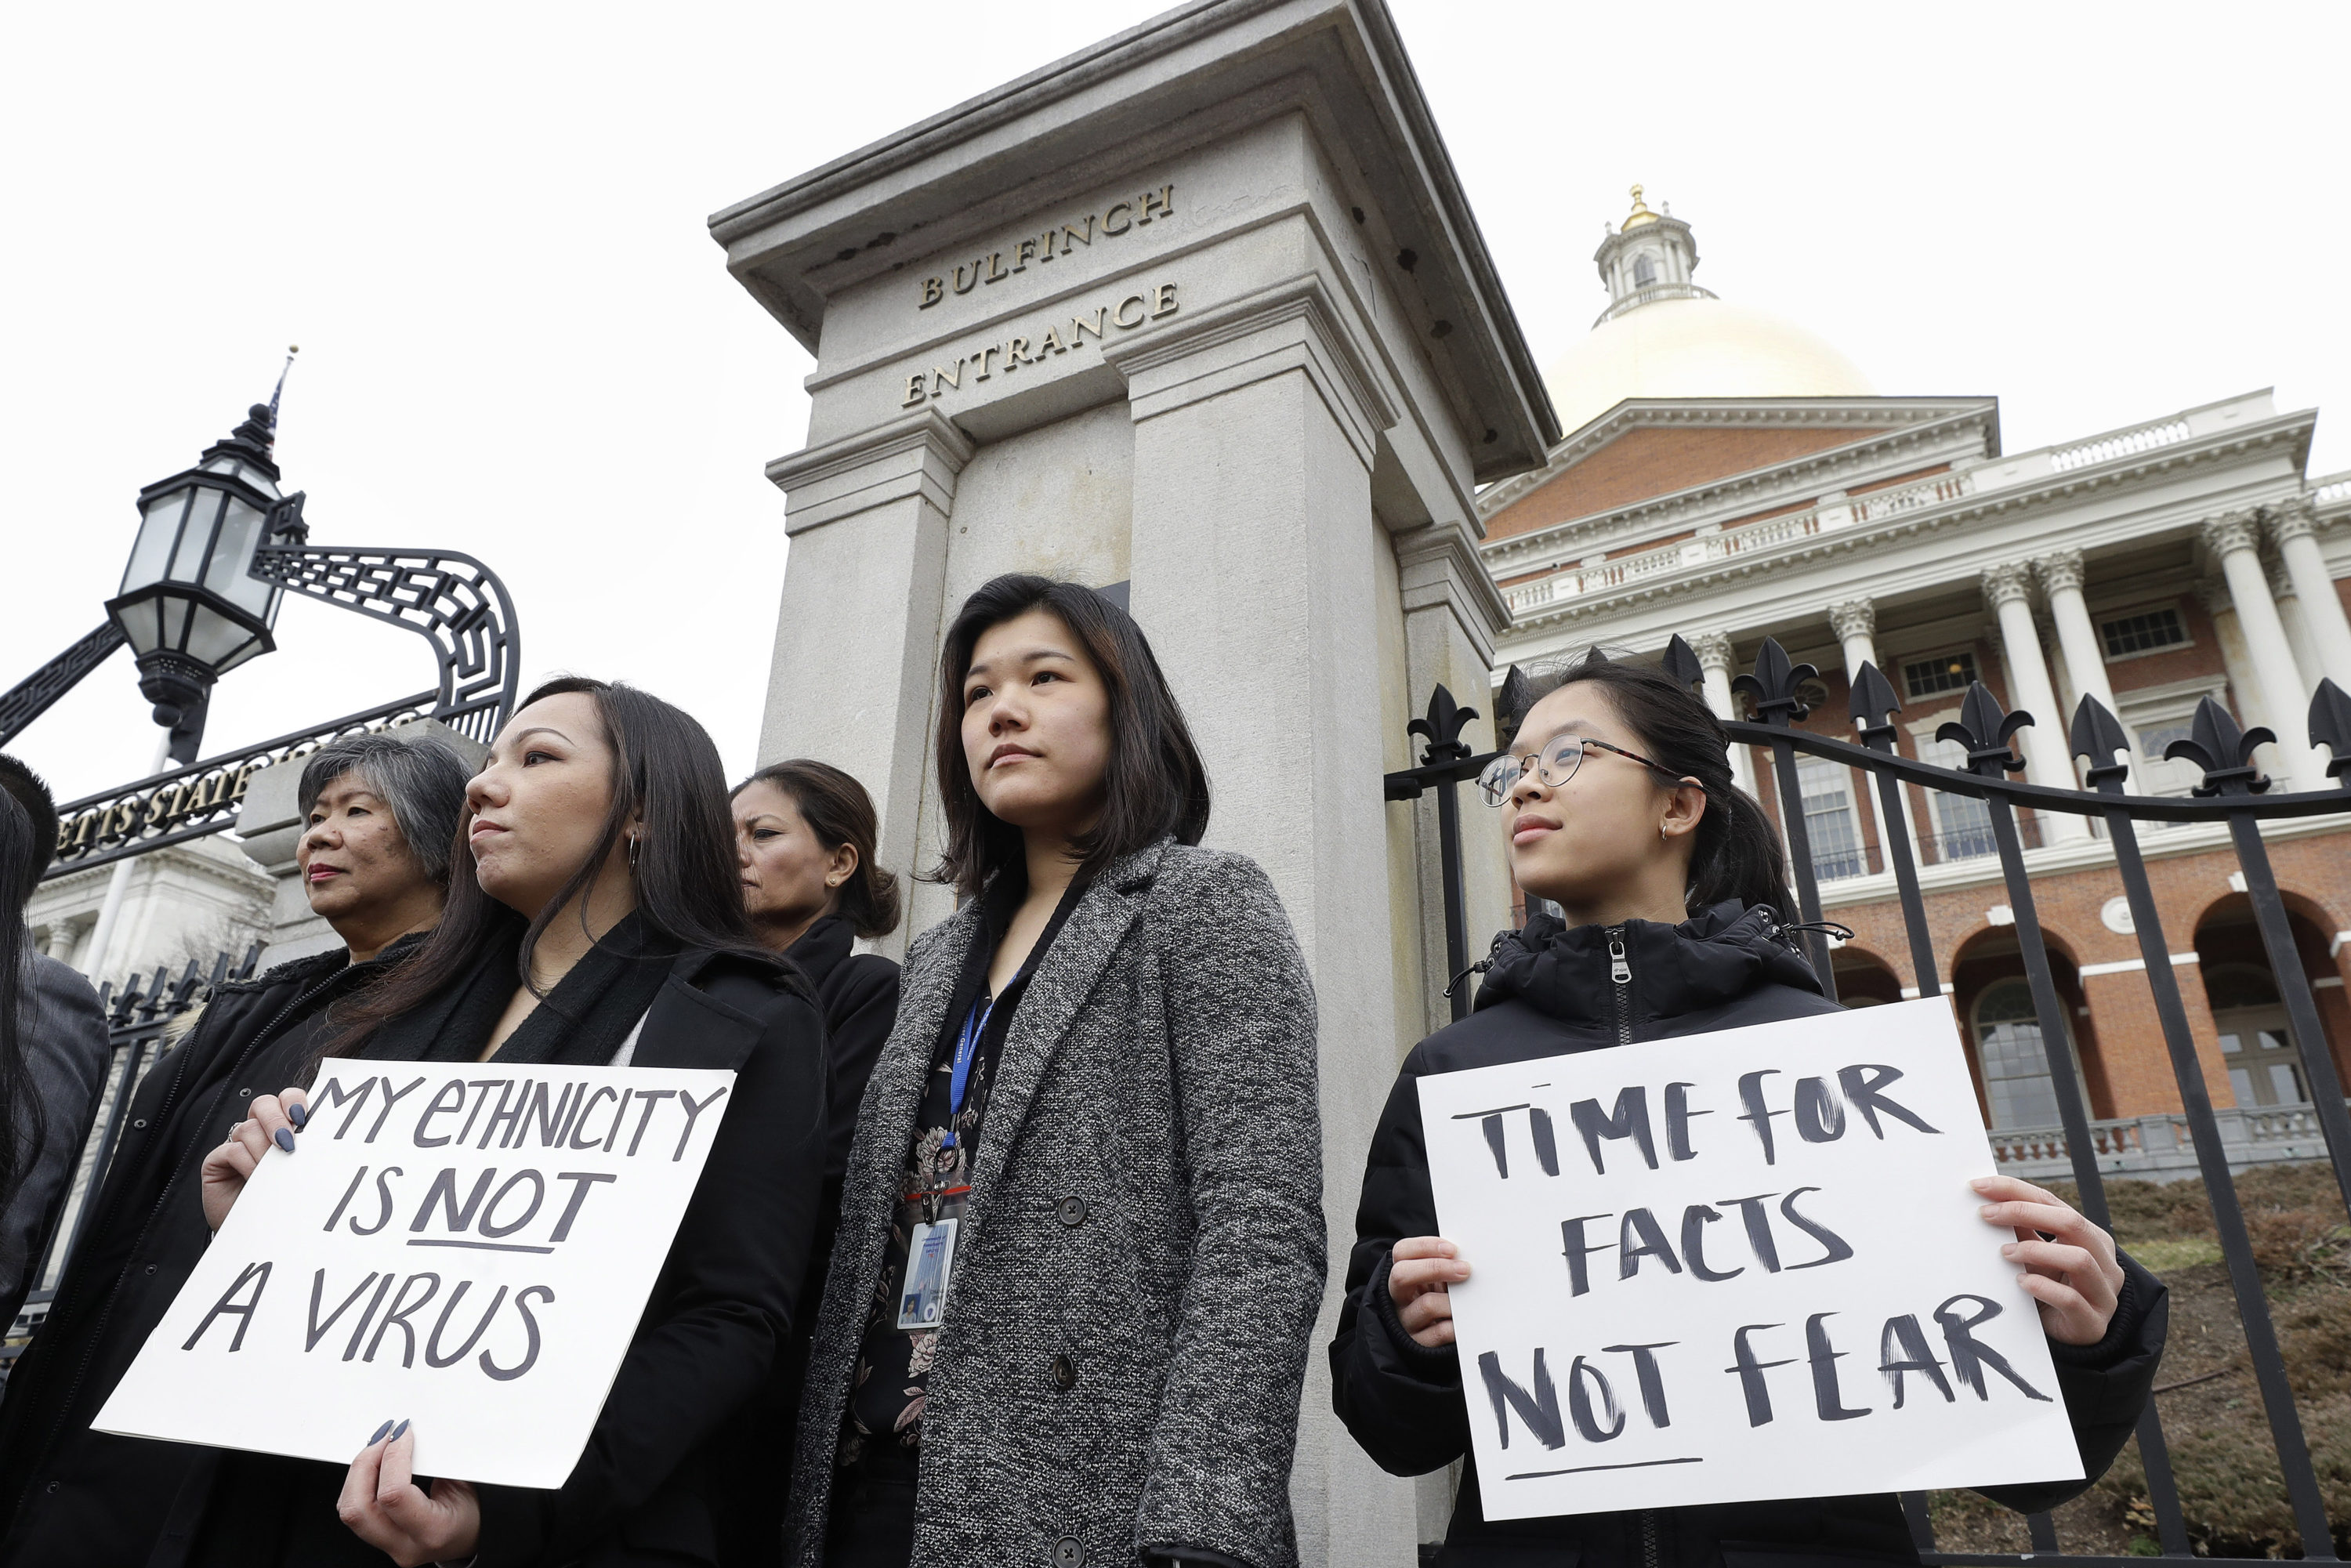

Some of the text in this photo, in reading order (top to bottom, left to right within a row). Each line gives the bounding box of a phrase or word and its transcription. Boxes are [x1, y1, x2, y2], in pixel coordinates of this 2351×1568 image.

[918, 184, 1174, 310] BULFINCH
[900, 281, 1179, 408] ENTRANCE
[144, 764, 256, 824] STATE
[957, 1037, 965, 1063] General
[295, 1076, 426, 1143] MY
[1737, 1064, 1945, 1166] FOR
[323, 1166, 617, 1242] IS NOT
[1561, 1186, 1854, 1298] FACTS
[181, 1261, 556, 1382] A VIRUS
[1478, 1294, 2055, 1451] NOT FEAR
